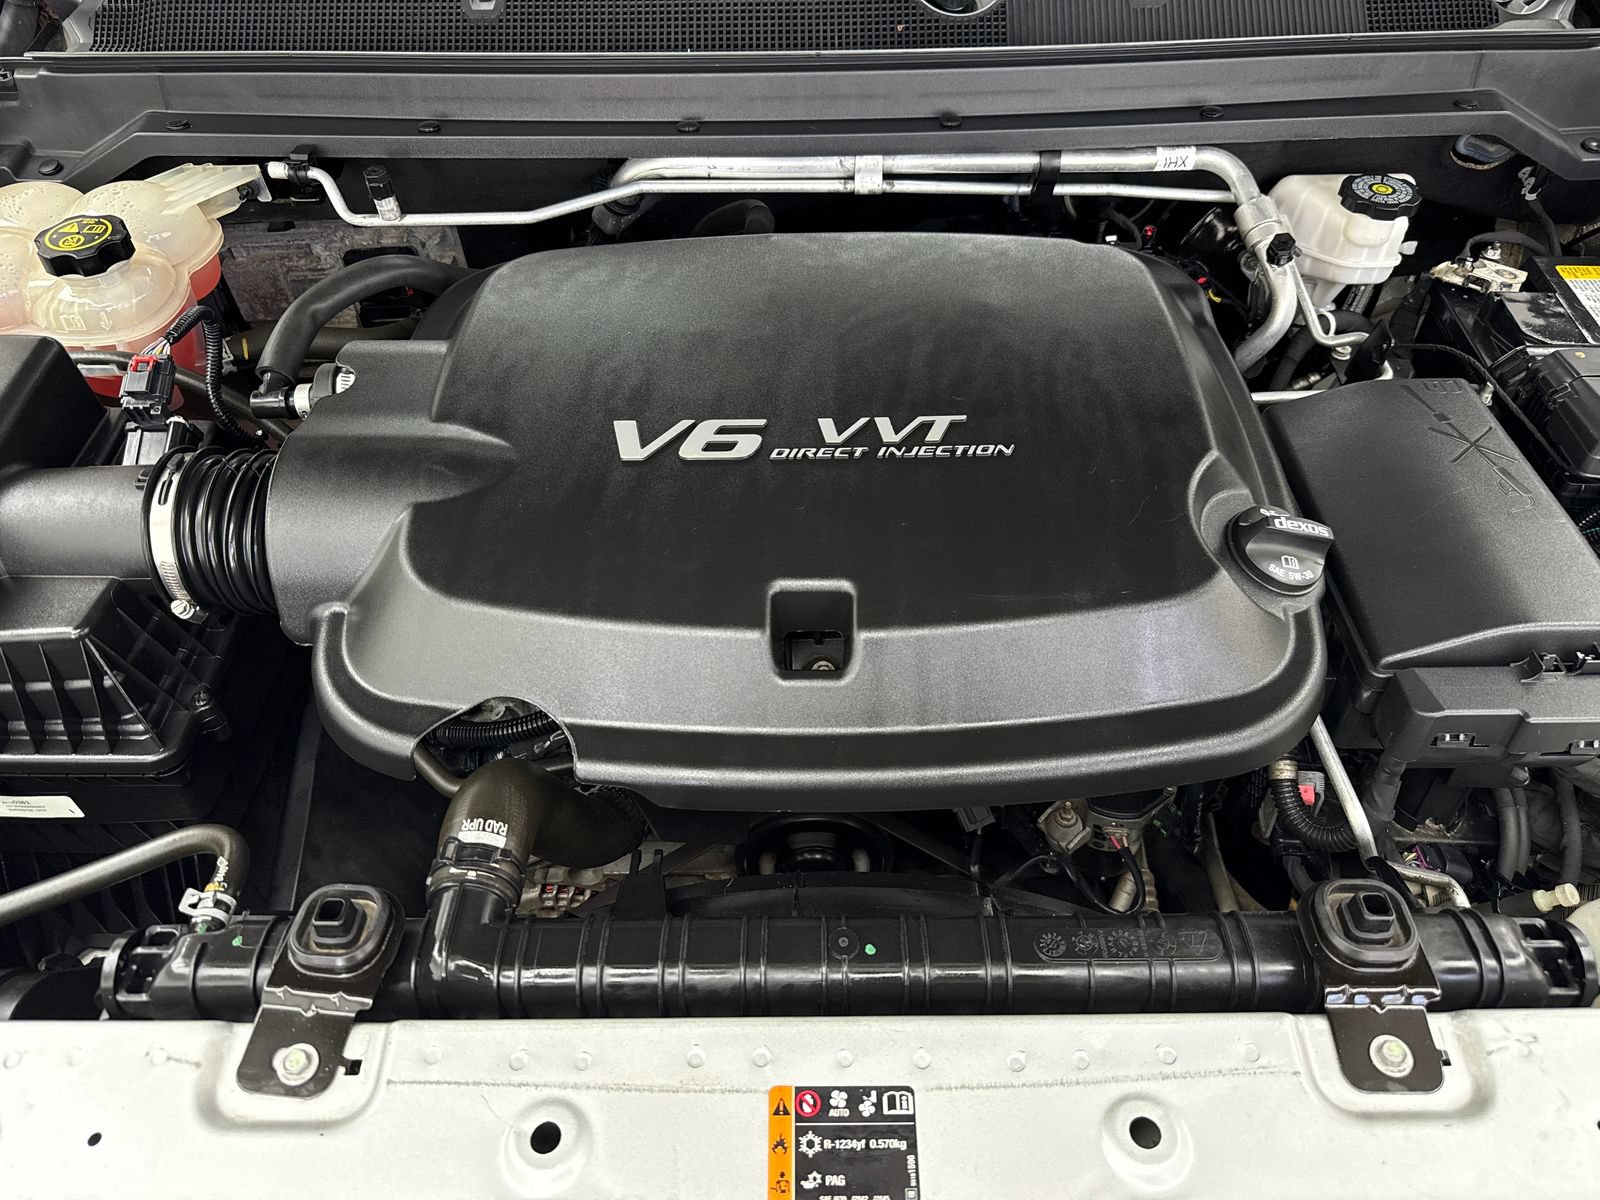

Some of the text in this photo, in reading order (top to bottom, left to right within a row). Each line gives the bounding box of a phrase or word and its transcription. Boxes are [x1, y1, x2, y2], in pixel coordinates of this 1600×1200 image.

[1163, 155, 1188, 168] IHX
[817, 414, 967, 444] VVT
[613, 418, 768, 461] V6
[769, 443, 1015, 461] DIRECT INJECTION
[1274, 517, 1329, 537] dexos
[1268, 563, 1286, 577] SAE
[462, 818, 508, 836] RAD UPR
[828, 1108, 850, 1117] AUTO
[823, 1139, 866, 1151] R-1234yf
[825, 1174, 846, 1186] PAG
